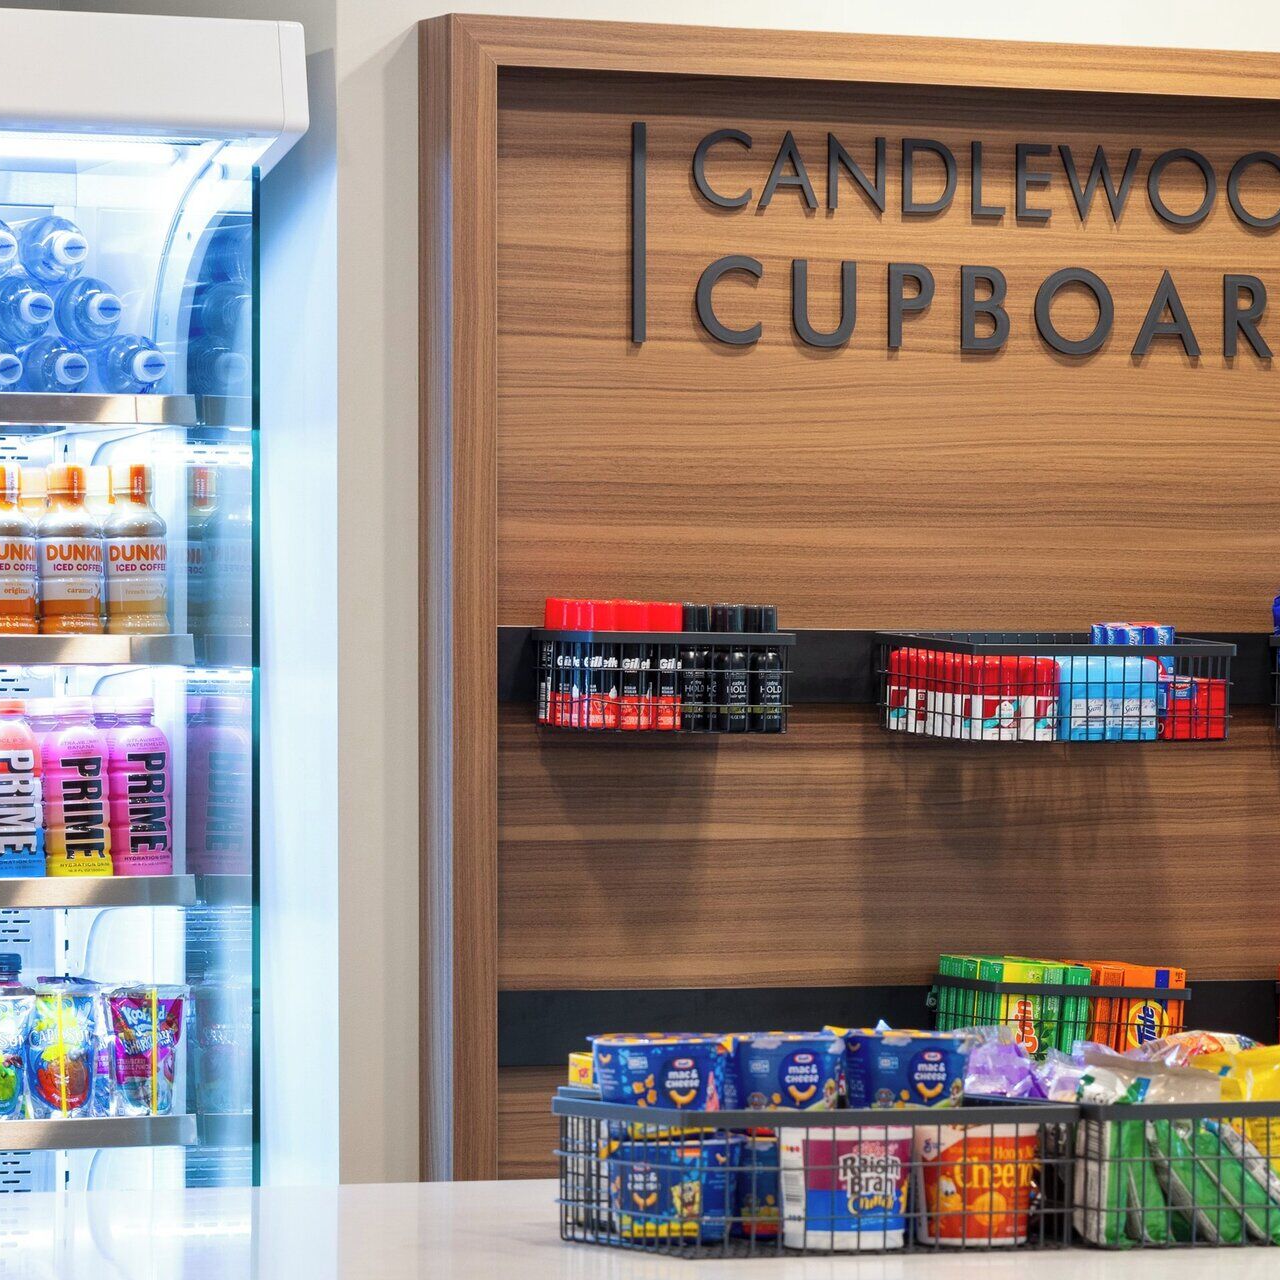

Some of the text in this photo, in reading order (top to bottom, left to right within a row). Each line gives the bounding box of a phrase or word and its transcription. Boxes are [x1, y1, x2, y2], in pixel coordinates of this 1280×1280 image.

[53, 563, 74, 572] ICED
[115, 563, 137, 572] ICED
[760, 685, 783, 694] HOLD
[59, 755, 106, 860] PRIME
[126, 751, 168, 854] PRIME
[1015, 999, 1039, 1054] Gain
[841, 1156, 900, 1177] Raisin
[850, 1174, 894, 1196] Bran
